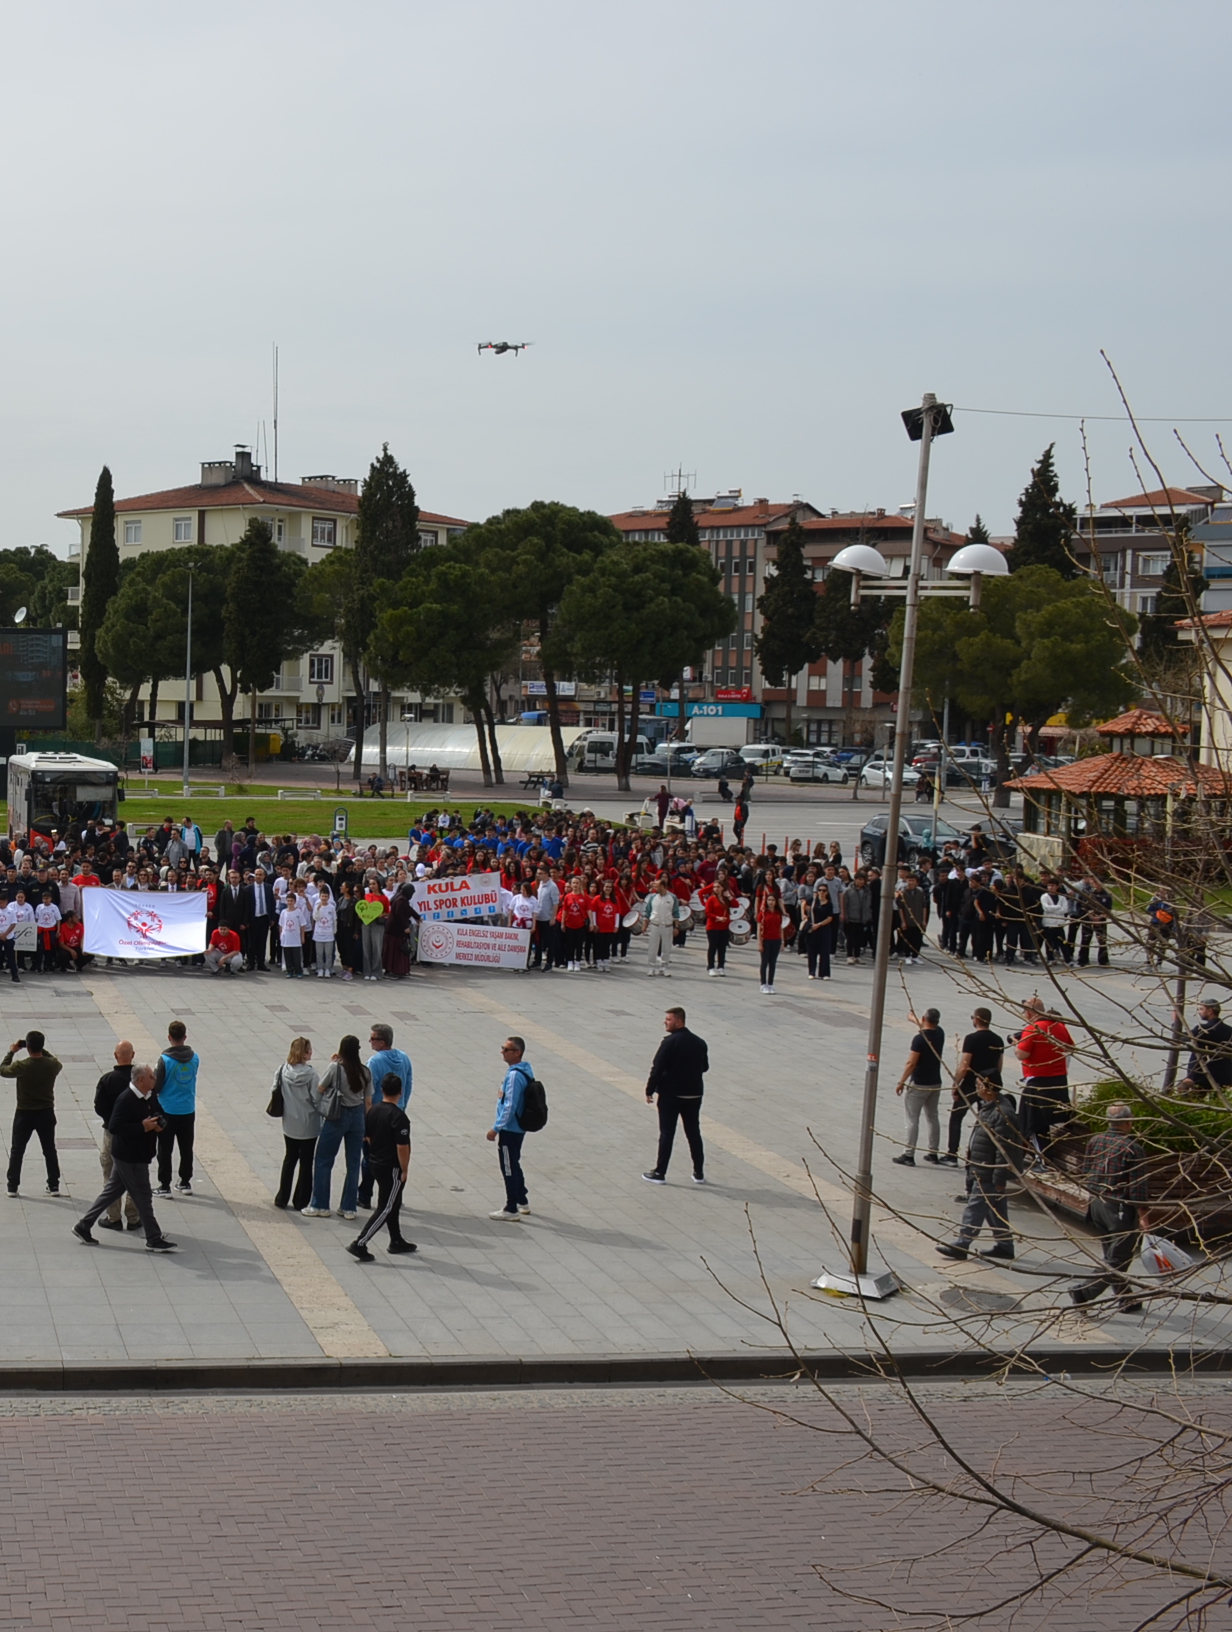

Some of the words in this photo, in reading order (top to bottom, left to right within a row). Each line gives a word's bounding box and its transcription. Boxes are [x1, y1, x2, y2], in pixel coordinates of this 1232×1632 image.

[427, 880, 471, 895] KULA
[417, 900, 432, 912] YIL
[433, 897, 458, 910] SPOR
[460, 889, 498, 909] KULUBÜ
[457, 928, 469, 936] KULA
[497, 941, 507, 951] AİLE
